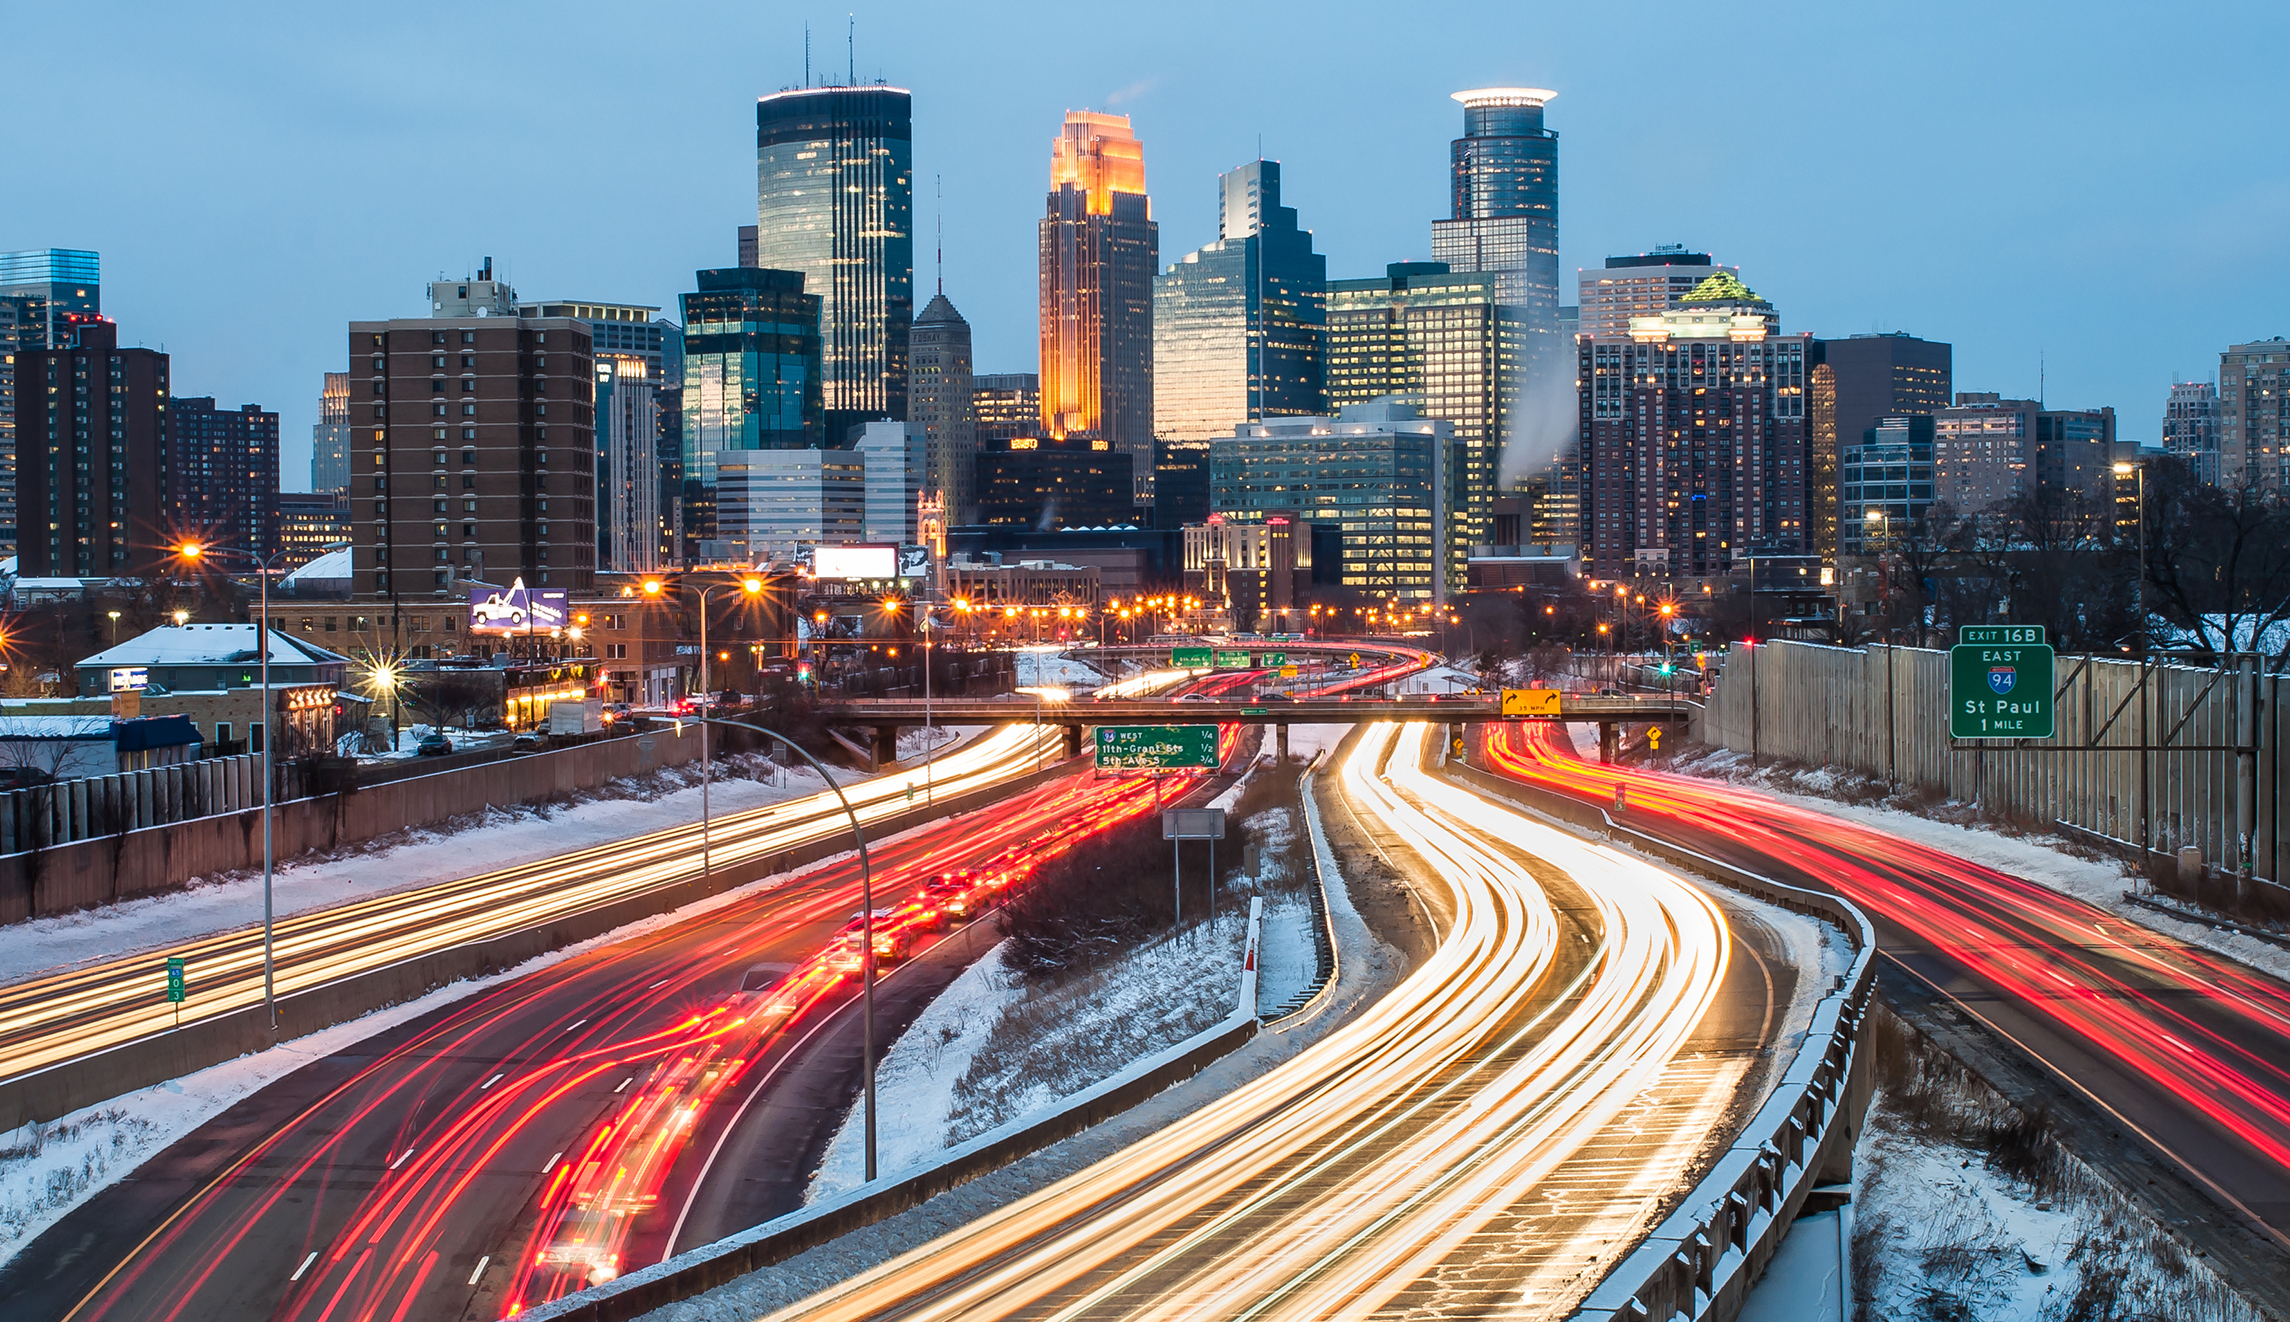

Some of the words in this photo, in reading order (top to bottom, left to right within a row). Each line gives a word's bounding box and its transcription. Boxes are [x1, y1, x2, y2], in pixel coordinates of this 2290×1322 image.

[913, 332, 941, 343] FOSHAY
[1968, 631, 1997, 640] EXIT
[2004, 629, 2036, 642] 16B
[1982, 651, 2021, 661] EAST
[1992, 674, 2012, 687] 94
[1965, 700, 1985, 714] St
[1996, 700, 2040, 714] Paul
[1981, 718, 1987, 732] 1
[1994, 720, 2023, 730] MILE
[1166, 743, 1183, 753] Sts
[1102, 756, 1122, 765] 5th
[1127, 756, 1148, 765] Ave
[1153, 756, 1160, 764] S
